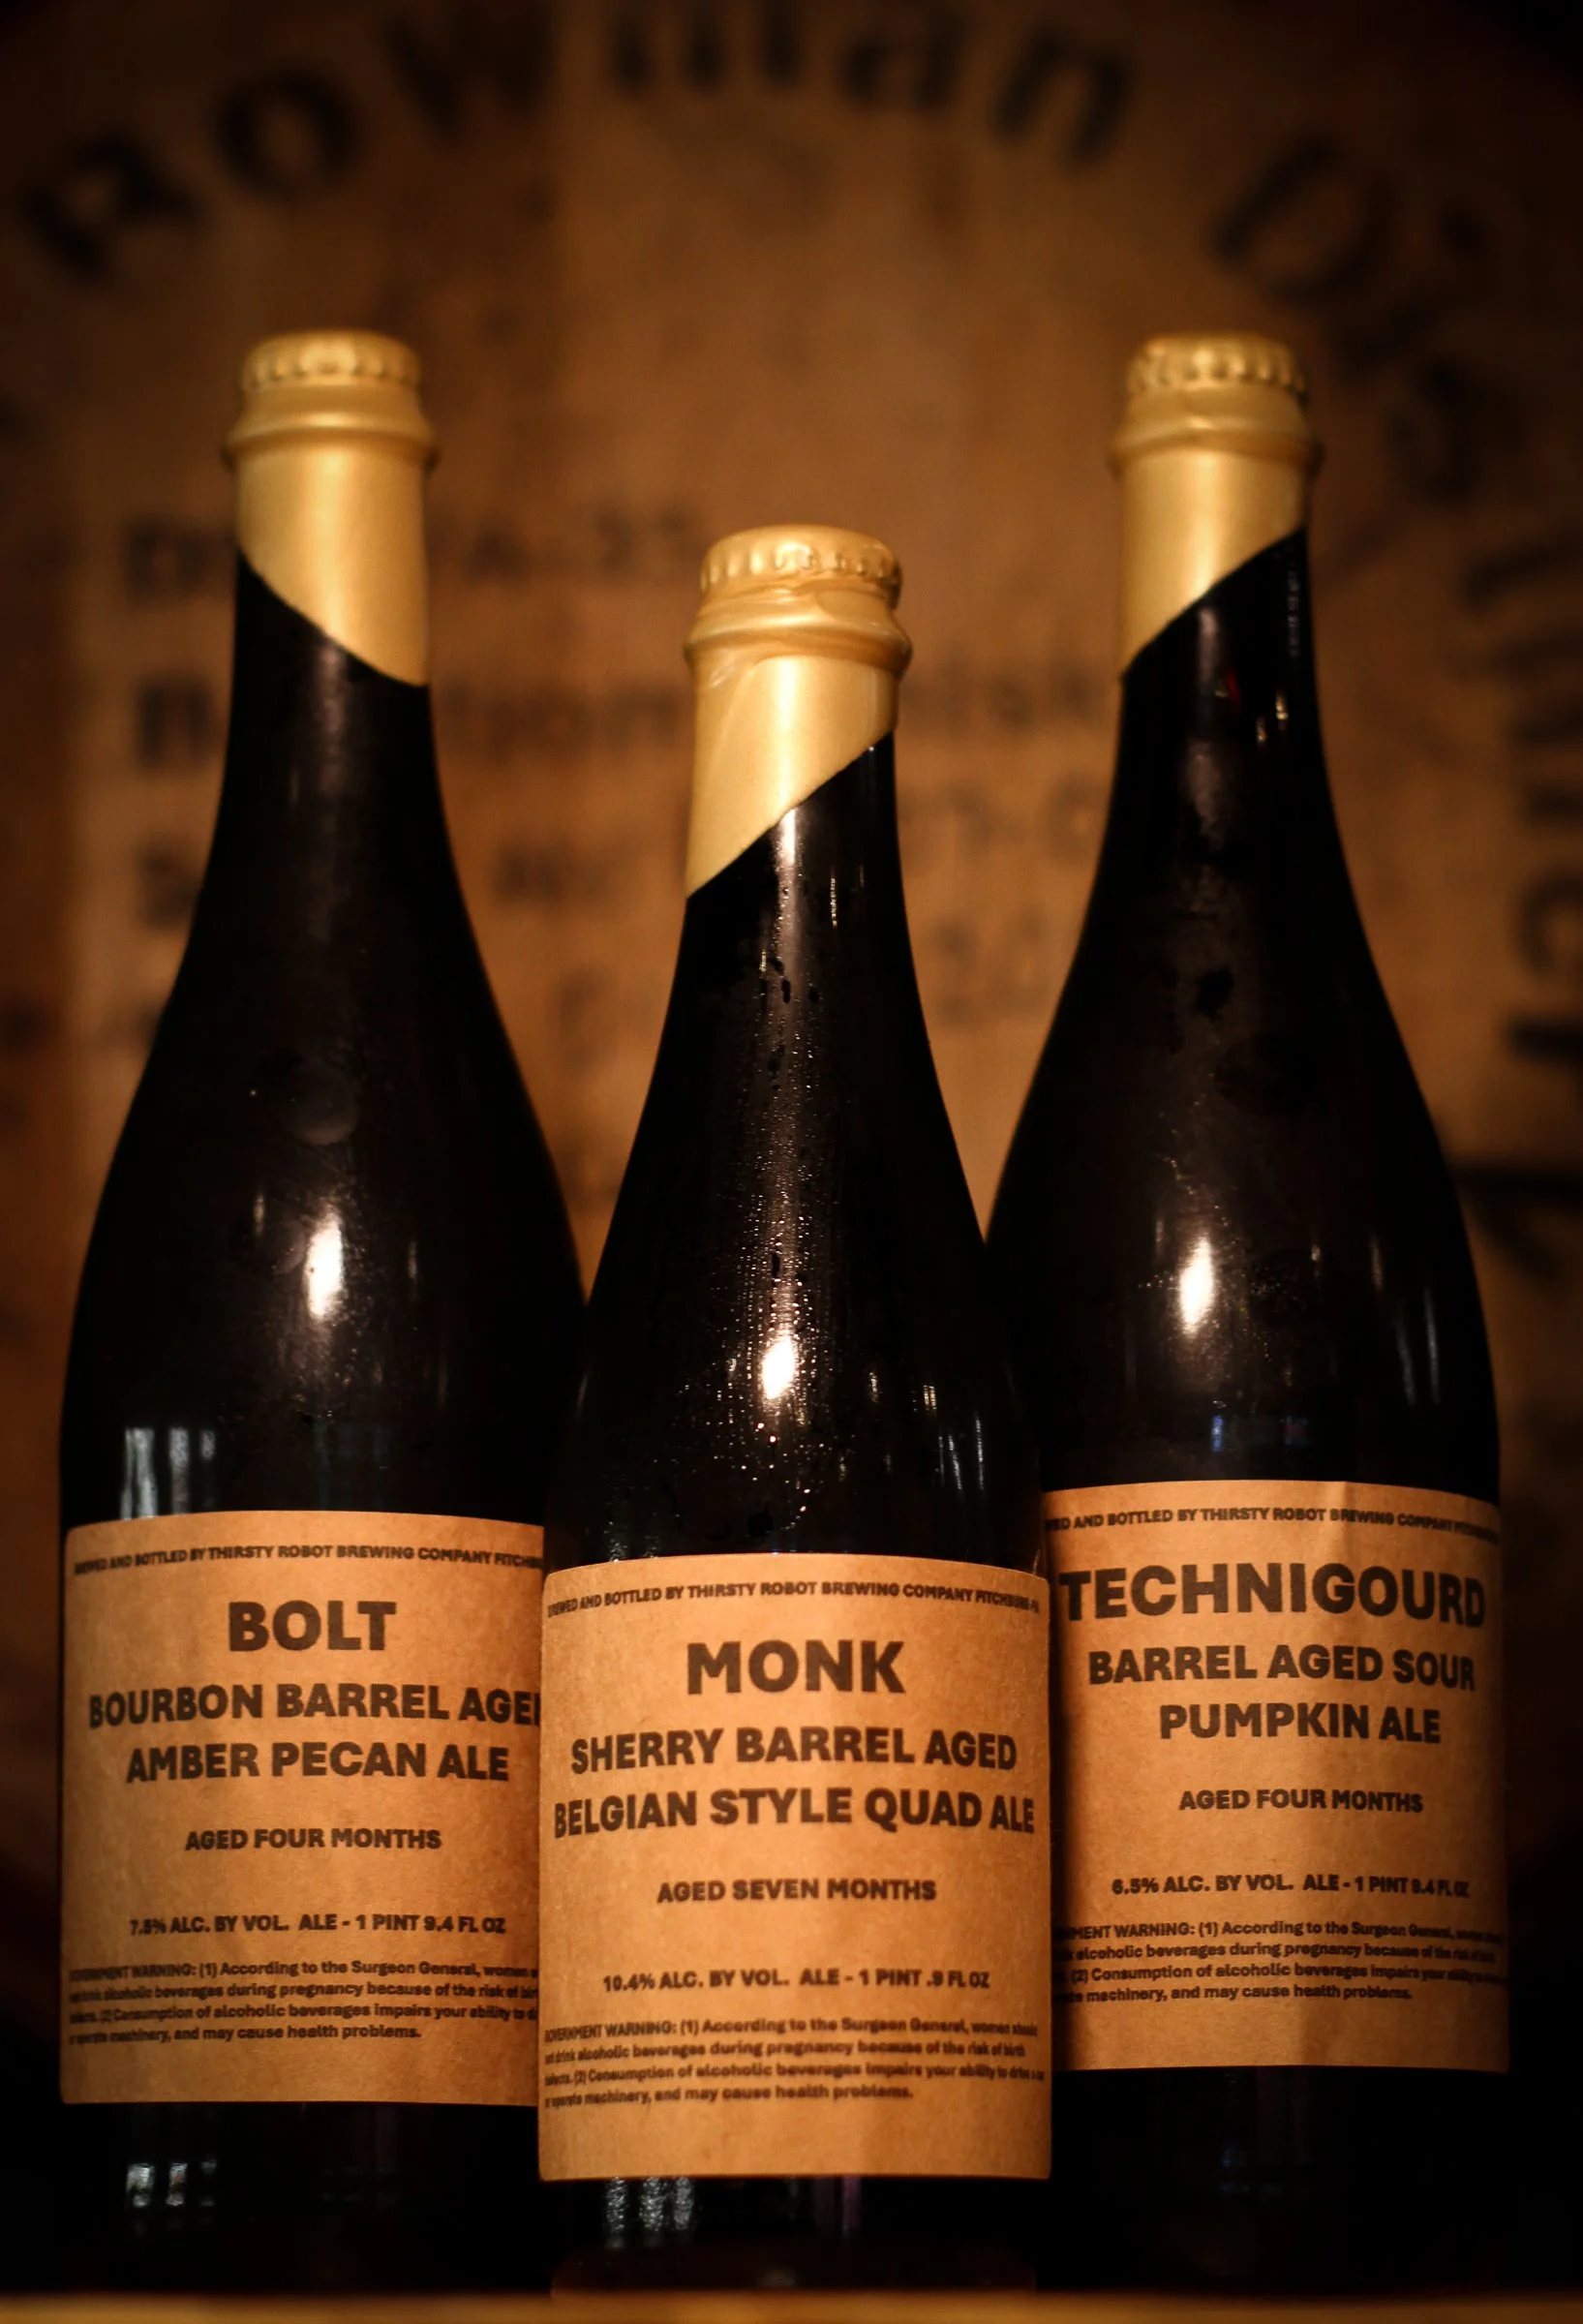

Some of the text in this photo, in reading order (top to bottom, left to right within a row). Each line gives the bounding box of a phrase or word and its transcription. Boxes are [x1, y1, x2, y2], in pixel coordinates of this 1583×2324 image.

[1074, 1514, 1104, 1529] AND
[1108, 1510, 1173, 1526] BOTTLED
[1177, 1509, 1197, 1521] BY
[1200, 1508, 1269, 1520] THIRSTY
[1273, 1508, 1326, 1521] ROBOT
[1330, 1509, 1394, 1525] BREWING
[109, 1545, 492, 1569] AND BOTTLED BY THIRSTY ROBOT BREWING COMPANY
[580, 1582, 973, 1609] AND BOTTLED BY THIRSTY ROBOT BREWING COMPANY
[1059, 1563, 1485, 1627] TECHNIGOURD
[228, 1601, 396, 1652] BOLT
[687, 1640, 905, 1695] MONK
[1089, 1644, 1476, 1691] BARREL AGED SOUR
[89, 1683, 541, 1729] BOURBON BARREL AGE
[1160, 1702, 1441, 1744] PUMPKIN ALE
[571, 1727, 1017, 1774] SHERRY BARREL AGED
[126, 1742, 509, 1784] AMBER PECAN ALE
[1179, 1789, 1423, 1813] AGED FOUR MONTHS
[555, 1788, 1034, 1838] BELGIAN STYLE QUAD ALE
[185, 1828, 441, 1850] AGED FOUR MONTHS
[657, 1879, 936, 1903] AGED SEVEN MONTHS
[1111, 1874, 1409, 1895] 6.5% ALC. BY VOL. ALE 1 PINT
[131, 1918, 167, 1935] 7.5%
[169, 1916, 210, 1933] ALC.
[214, 1915, 238, 1933] BY
[242, 1915, 289, 1931] VOL.
[298, 1913, 337, 1930] ALE
[356, 1914, 365, 1930] 1
[373, 1914, 419, 1931] PINT
[424, 1916, 454, 1932] 9.4
[482, 1917, 506, 1935] OZ
[1113, 1921, 1407, 1939] WARNING: (1) According to the Surgeon
[1076, 1944, 1142, 1962] alcoholic
[1146, 1944, 1226, 1959] beverages
[1229, 1942, 1282, 1958] during
[1284, 1944, 1361, 1958] pregnancy
[1364, 1943, 1419, 1958] because
[199, 1963, 217, 1978] (1)
[220, 1962, 298, 1976] According
[301, 1963, 318, 1973] to
[321, 1961, 348, 1973] the
[351, 1960, 415, 1976] Surgeon
[418, 1961, 480, 1977] General,
[1072, 1969, 1088, 1985] (2)
[1091, 1966, 1193, 1981] Consumption
[1196, 1965, 1212, 1977] of
[1215, 1963, 1291, 1976] alcoholic
[1294, 1963, 1368, 1980] beverages
[1371, 1965, 1420, 1980] impairs
[155, 1986, 224, 2001] beverages
[227, 1983, 277, 1999] during
[279, 1984, 363, 1999] pregnancy
[367, 1982, 432, 1996] because
[435, 1983, 450, 1996] of
[452, 1984, 476, 1997] the
[478, 1984, 505, 1998] risk
[604, 1969, 989, 1992] 10.4% ALC. BY VOL. ALE 1 PINT .9 FL OZ
[1086, 1984, 1412, 2003] machinery, and may cause health problems.
[113, 2006, 194, 2022] Consumption
[196, 2005, 211, 2019] of
[213, 2004, 286, 2018] alcoholic
[289, 2004, 371, 2019] beverages
[375, 2003, 432, 2019] impairs
[434, 2007, 467, 2020] your
[174, 2025, 421, 2041] and may cause health problems.
[605, 2018, 968, 2036] WARNING: (1) According to the Surgeon General,
[577, 2046, 628, 2061] alcoholic
[633, 2045, 705, 2059] beverages
[711, 2043, 762, 2057] during
[767, 2043, 852, 2057] pregnancy
[858, 2042, 922, 2054] because
[926, 2041, 940, 2054] of
[943, 2042, 964, 2055] the
[968, 2043, 989, 2055] risk
[589, 2068, 674, 2082] Consumption
[678, 2065, 692, 2077] of
[696, 2064, 772, 2077] alcoholic
[776, 2064, 861, 2079] beverages
[867, 2064, 922, 2078] impairs
[927, 2066, 956, 2078] your
[585, 2086, 912, 2104] machinery, and may cause health problems.
